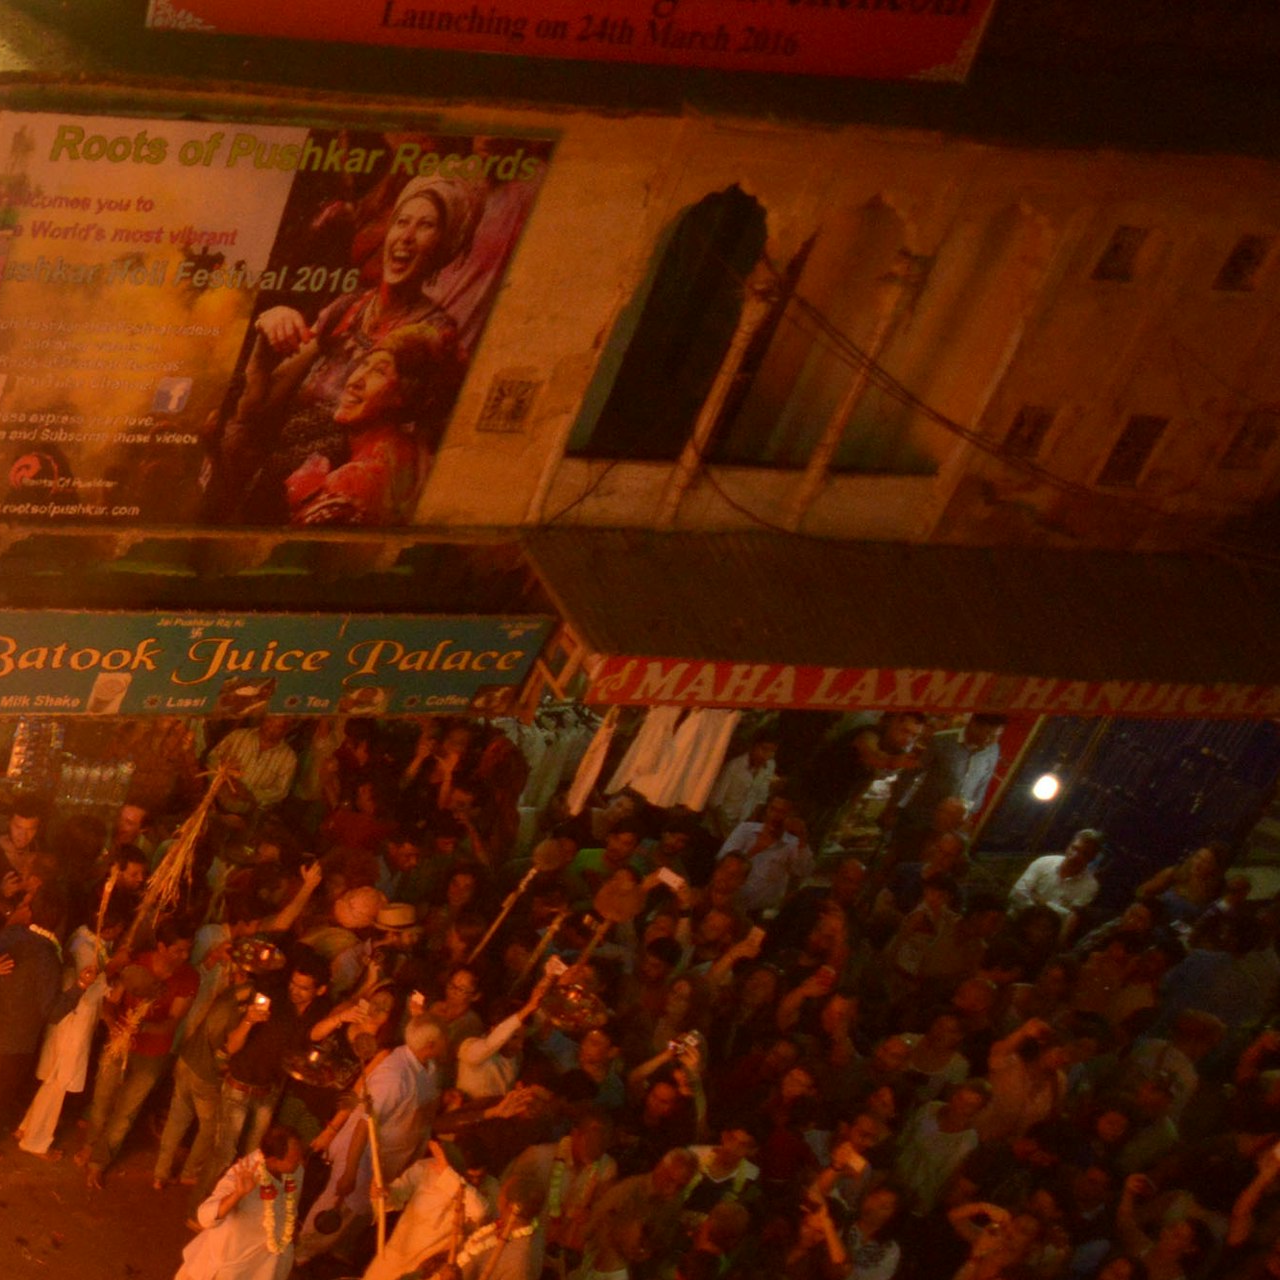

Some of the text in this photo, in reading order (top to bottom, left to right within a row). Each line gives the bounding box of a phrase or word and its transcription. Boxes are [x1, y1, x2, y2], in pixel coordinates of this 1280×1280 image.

[535, 18, 569, 40] on
[48, 124, 540, 182] Roots of Pushkar Records
[94, 197, 132, 215] you
[135, 195, 155, 213] to
[30, 220, 107, 242] World's
[110, 226, 165, 245] most
[169, 225, 239, 247] vibrant
[171, 261, 289, 291] Festival
[291, 265, 362, 294] 2016
[170, 637, 331, 687] Juice
[342, 639, 524, 687] Palace
[630, 661, 796, 705] MAHA
[807, 667, 995, 709] LAXMI
[0, 694, 81, 708] Milk Shake
[165, 696, 208, 708] Lassi
